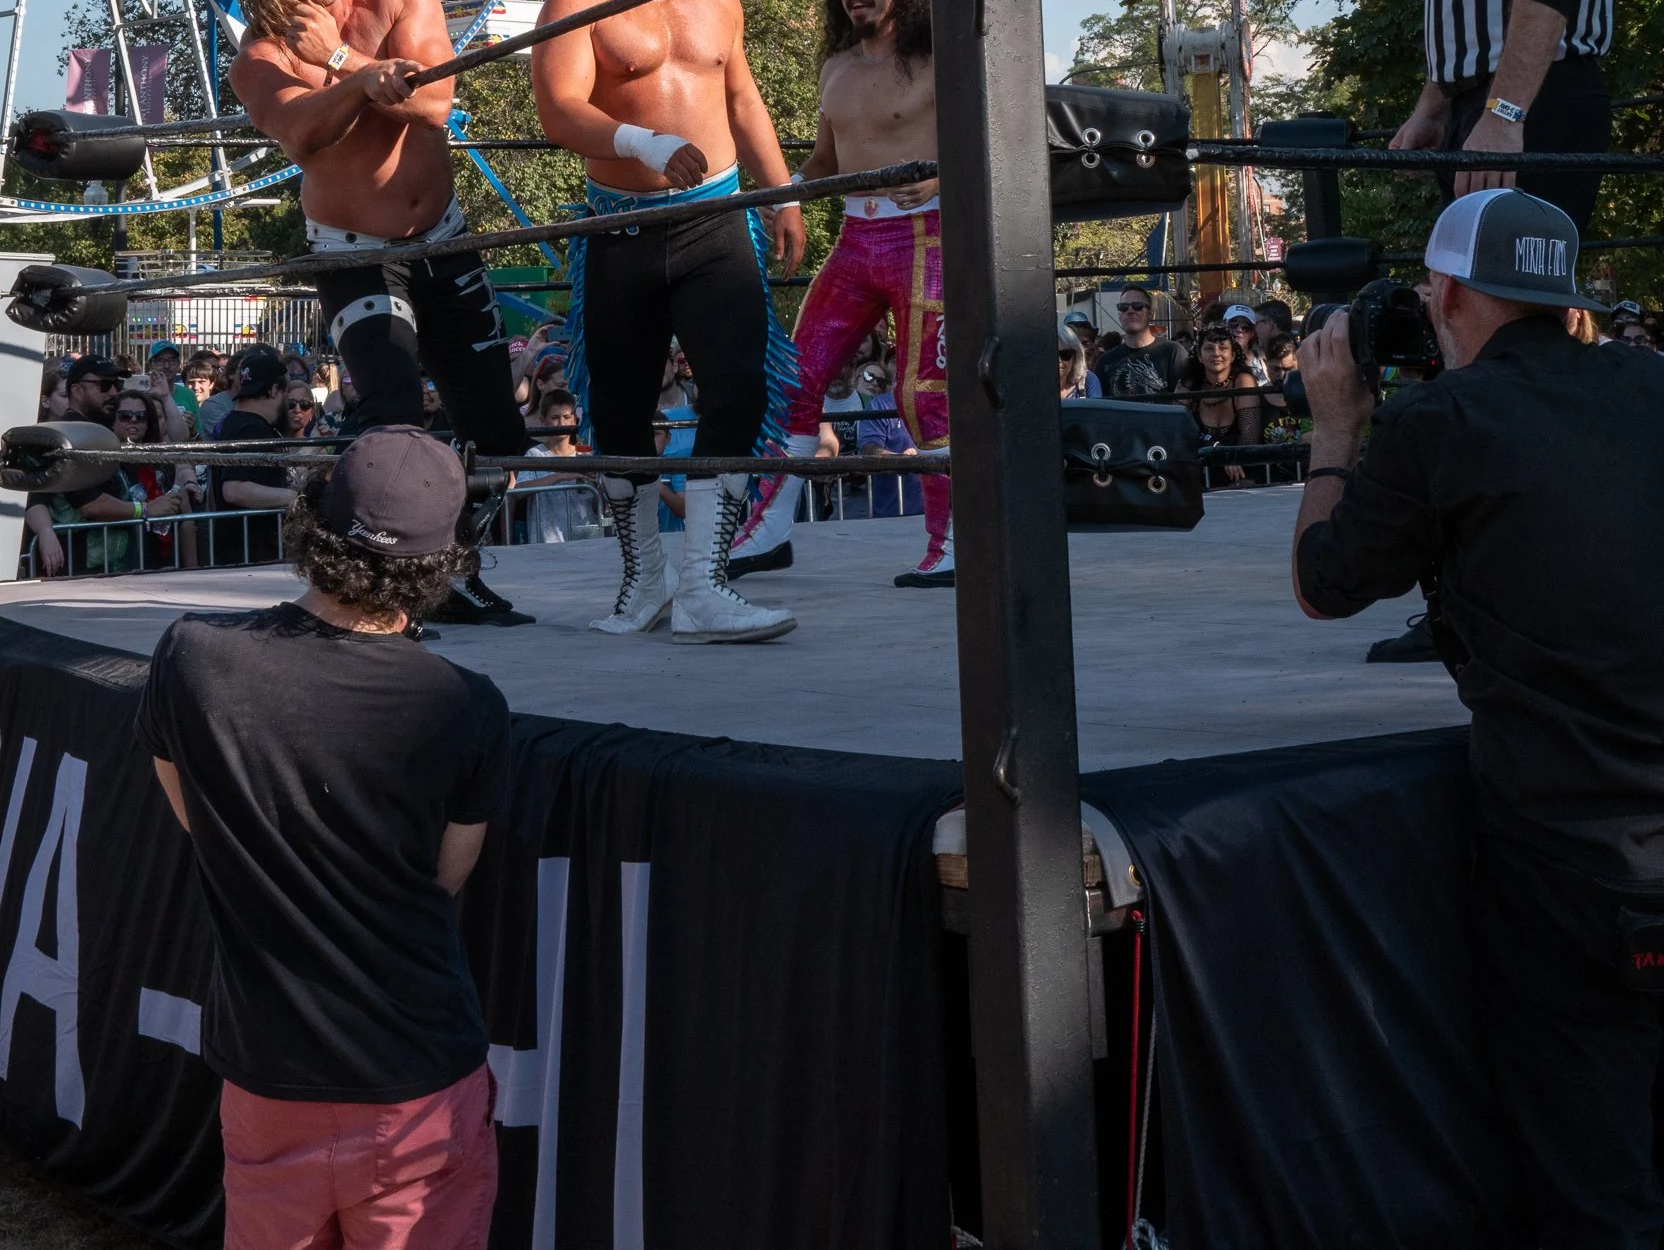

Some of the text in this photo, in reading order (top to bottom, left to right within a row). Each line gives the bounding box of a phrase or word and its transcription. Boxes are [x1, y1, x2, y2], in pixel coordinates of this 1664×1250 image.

[83, 57, 93, 102] NTHONY
[141, 55, 149, 104] ANTHONY
[1515, 236, 1546, 277] MIRTH
[347, 518, 398, 545] Yankees
